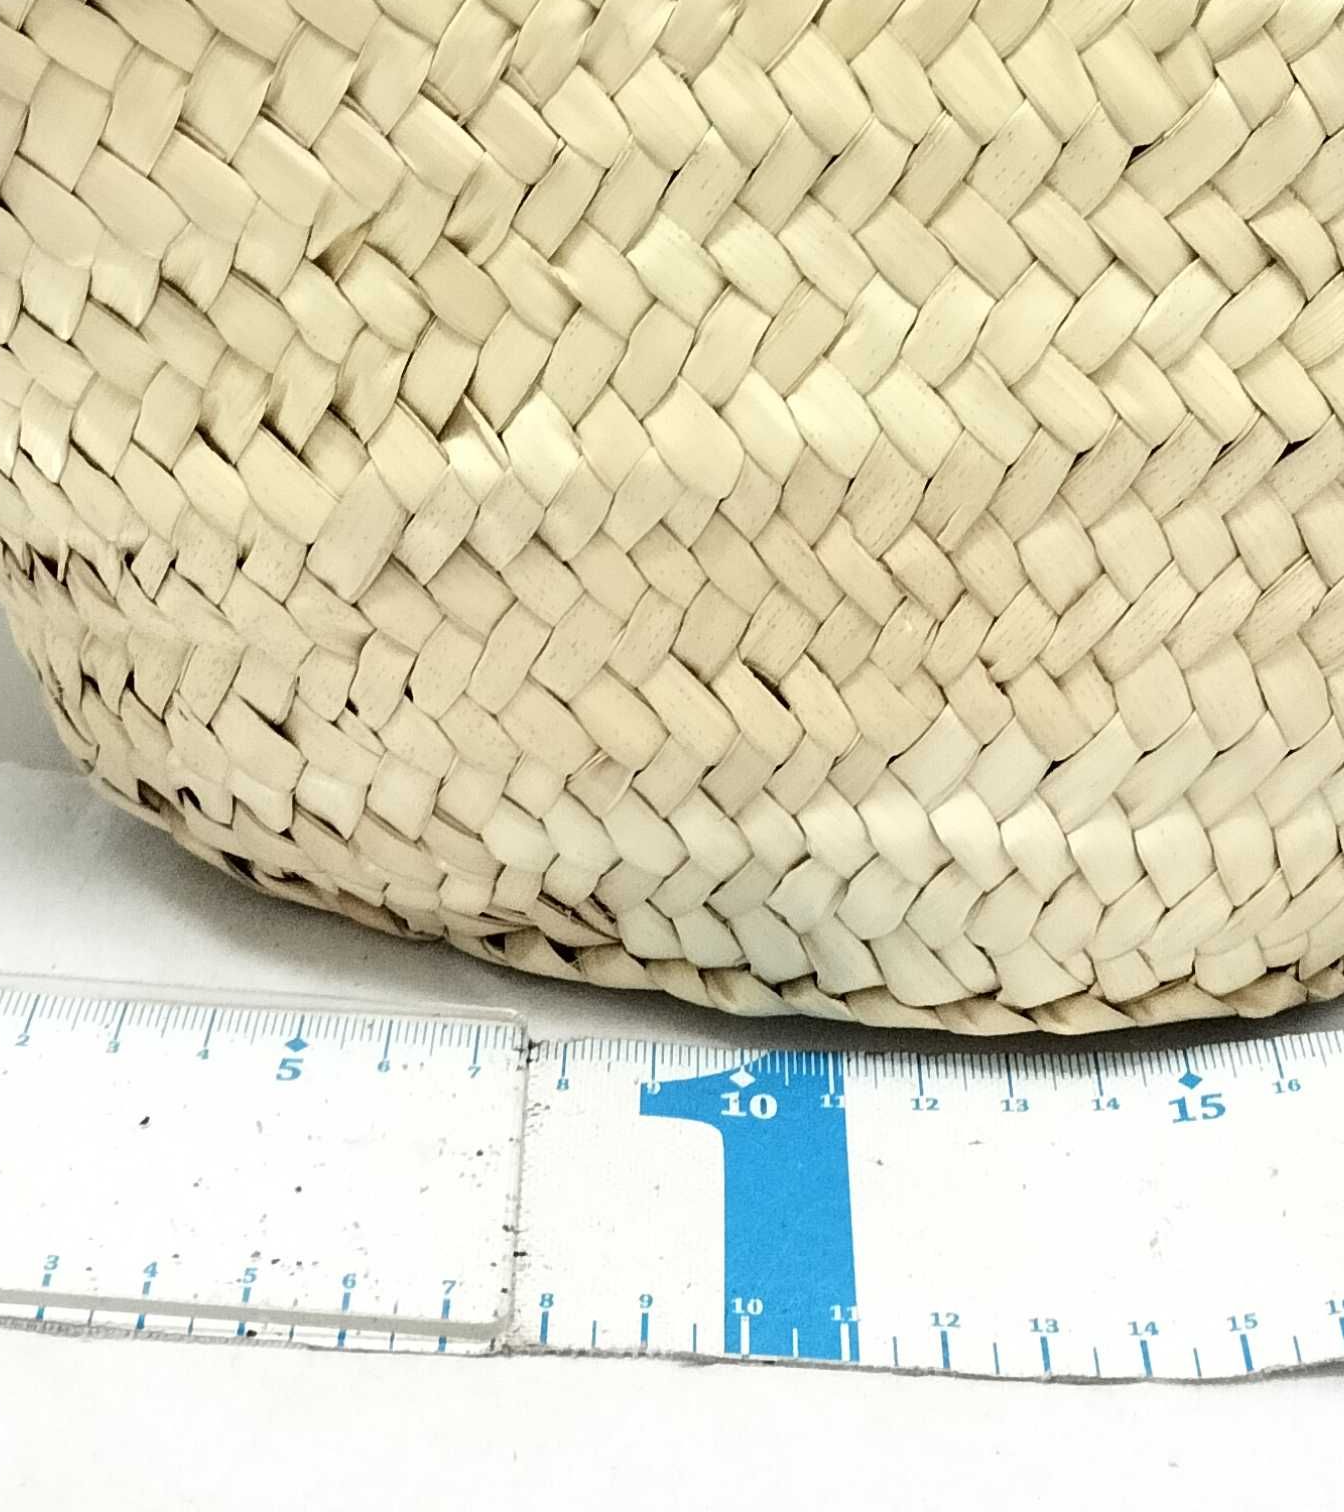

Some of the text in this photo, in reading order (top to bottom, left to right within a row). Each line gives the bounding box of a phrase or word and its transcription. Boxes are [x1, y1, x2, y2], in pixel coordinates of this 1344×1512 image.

[16, 1035, 31, 1047] 2
[195, 1049, 209, 1060] 4
[275, 1058, 305, 1081] 5
[377, 1061, 391, 1073] 6
[468, 1066, 481, 1079] 7
[556, 1078, 569, 1090] 8
[720, 1091, 778, 1119] 10
[911, 1097, 940, 1112] 12
[1001, 1098, 1030, 1113] 13
[1091, 1098, 1121, 1112] 14
[1168, 1093, 1227, 1124] 15
[1271, 1078, 1301, 1094] 16
[639, 1050, 860, 1362] 1
[44, 1255, 60, 1271] 3
[142, 1261, 159, 1278] 4
[242, 1267, 259, 1284] 5
[341, 1273, 358, 1289] 6
[441, 1280, 457, 1296] 7
[538, 1293, 554, 1309] 8
[639, 1294, 654, 1310] 9
[730, 1298, 764, 1317] 10
[829, 1305, 861, 1323] 11
[930, 1312, 961, 1328] 12
[1028, 1318, 1060, 1335] 13
[1127, 1320, 1159, 1338] 14
[1227, 1314, 1258, 1333] 15
